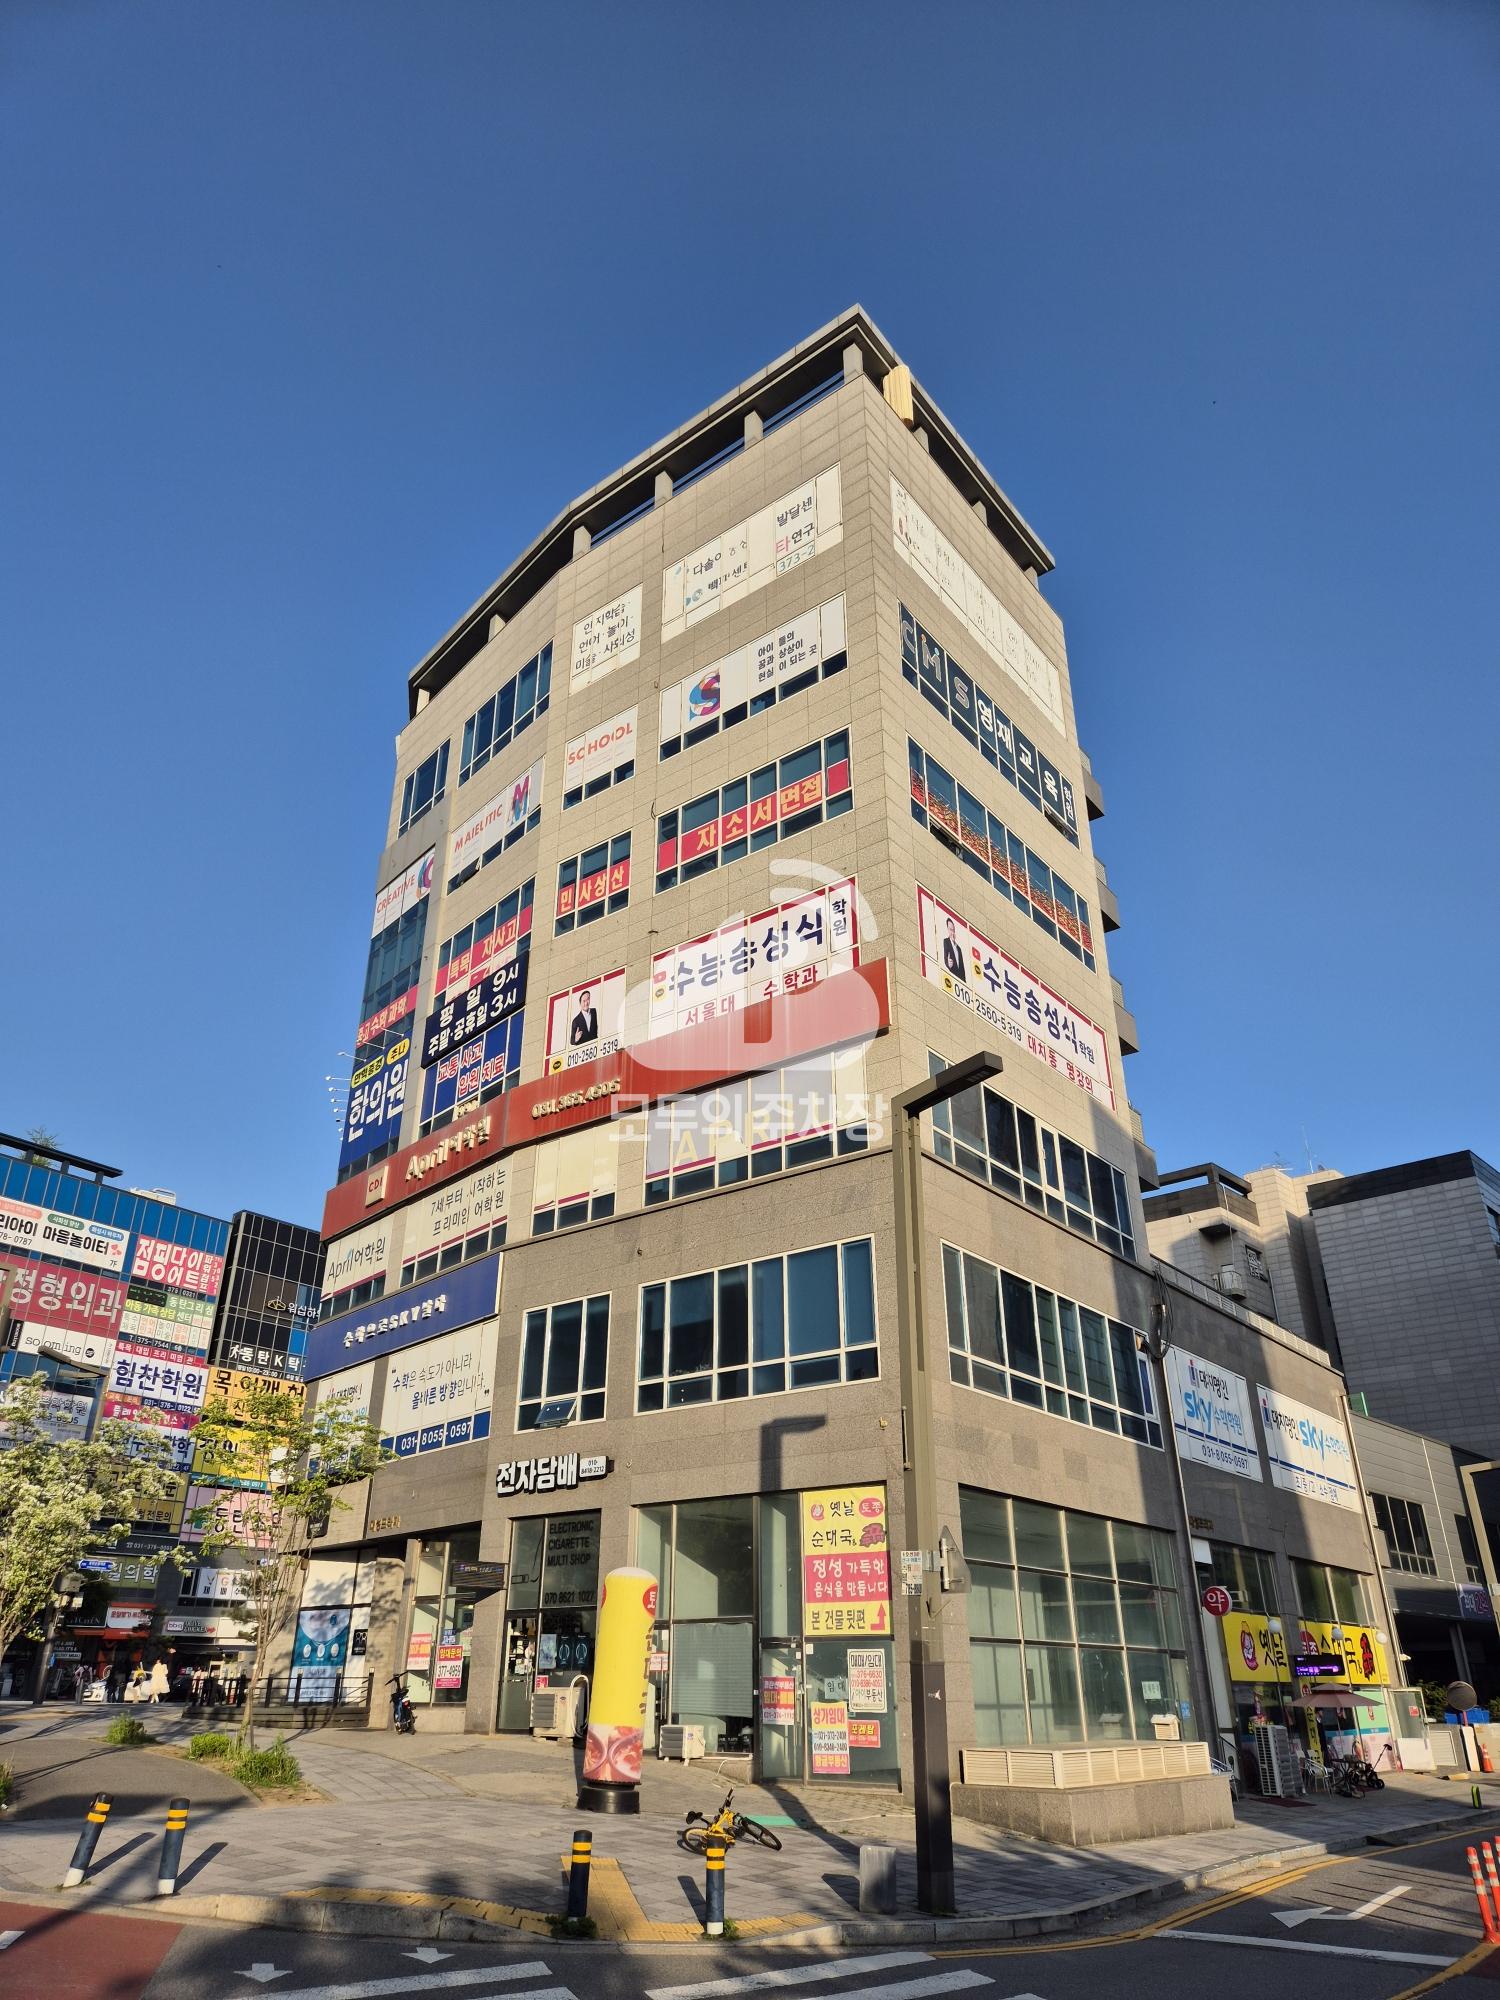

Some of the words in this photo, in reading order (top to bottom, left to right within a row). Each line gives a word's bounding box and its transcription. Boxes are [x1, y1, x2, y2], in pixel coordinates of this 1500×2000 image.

[780, 774, 822, 814] 면접
[668, 907, 824, 997] 수능송성식
[491, 961, 520, 993] 9시
[490, 988, 517, 1018] 3시
[982, 956, 1079, 1055] 수능송성식
[1079, 1040, 1097, 1065] 학원
[953, 983, 1023, 1042] 010-2560-5319
[1027, 1034, 1058, 1069] 대치동
[567, 1038, 620, 1067] 010-2560-5319
[347, 1059, 409, 1143] 한의원
[368, 1176, 384, 1194] CDI
[42, 1225, 110, 1256] 마음놀이터
[115, 1359, 203, 1400] 힘찬학원
[392, 1370, 417, 1392] 수학은
[418, 1361, 445, 1384] 속도가
[445, 1352, 473, 1375] 아니라
[400, 1420, 473, 1452] 031-8055-0597
[497, 1452, 578, 1494] 전자담배
[829, 1499, 855, 1518] 옛날
[861, 1501, 882, 1514] 토종
[549, 1519, 595, 1535] ELECTRONIC
[811, 1528, 853, 1548] 순대국
[549, 1536, 591, 1551] CIGARETTE
[547, 1553, 569, 1567] MULTI
[569, 1552, 592, 1566] SHOP
[813, 1558, 843, 1579] 정성
[846, 1559, 885, 1577] 가득한
[813, 1580, 844, 1598] 음식을
[846, 1580, 888, 1598] 만듭니다
[1206, 1590, 1225, 1612] 약
[811, 1609, 821, 1631] 본
[813, 1707, 845, 1725] 상가임대
